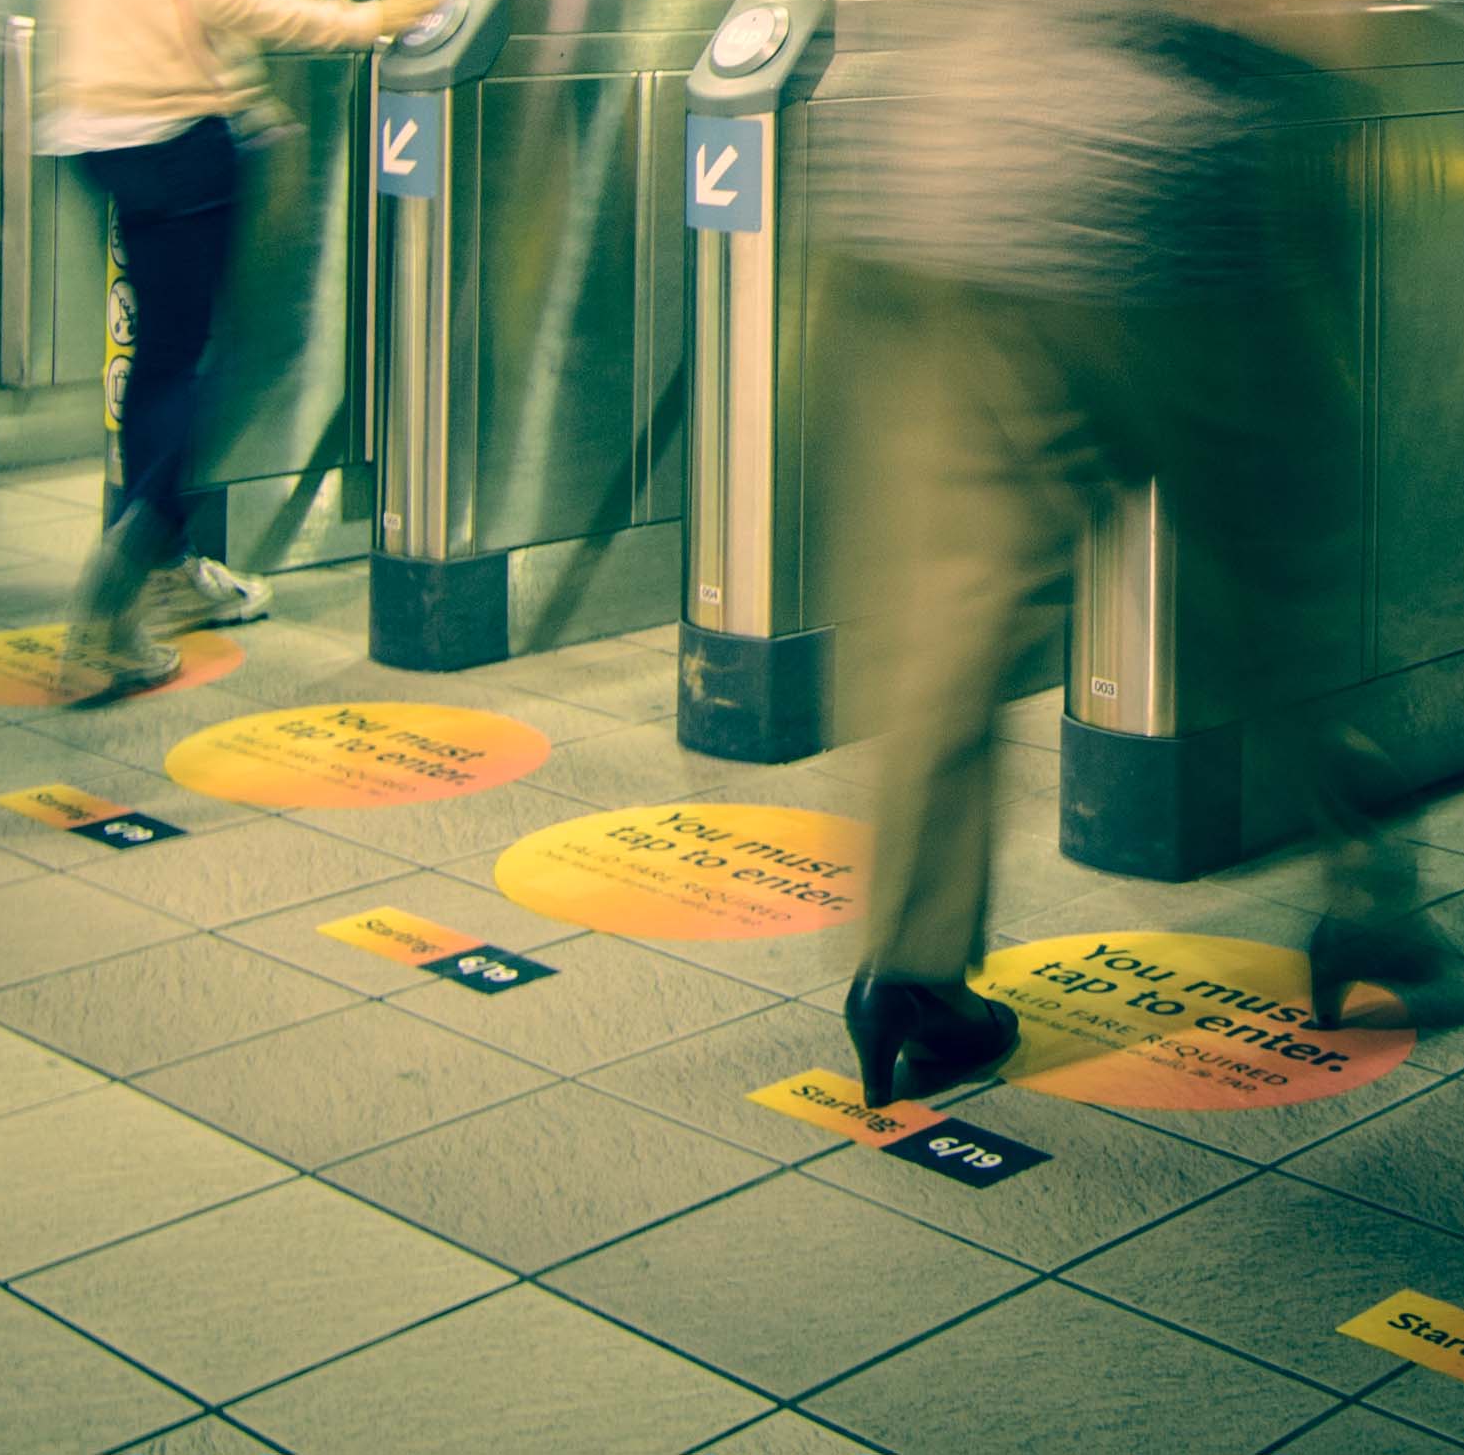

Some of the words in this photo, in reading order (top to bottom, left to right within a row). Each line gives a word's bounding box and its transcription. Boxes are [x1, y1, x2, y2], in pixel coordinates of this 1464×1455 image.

[1094, 680, 1115, 696] 003
[276, 720, 335, 740] tap
[335, 738, 376, 752] to
[324, 709, 389, 732] You
[386, 731, 485, 763] must
[606, 825, 677, 851] tap
[679, 849, 728, 868] to
[731, 867, 853, 911] enter.
[656, 812, 733, 842] You
[733, 841, 854, 878] must
[1082, 944, 1176, 982] You
[1031, 961, 1118, 994] tap
[1125, 990, 1185, 1016] to
[1194, 1016, 1350, 1073] enter.
[1066, 1009, 1139, 1035] FARE
[1141, 1032, 1289, 1086] REQUIRED
[928, 1136, 1003, 1168] 6/19
